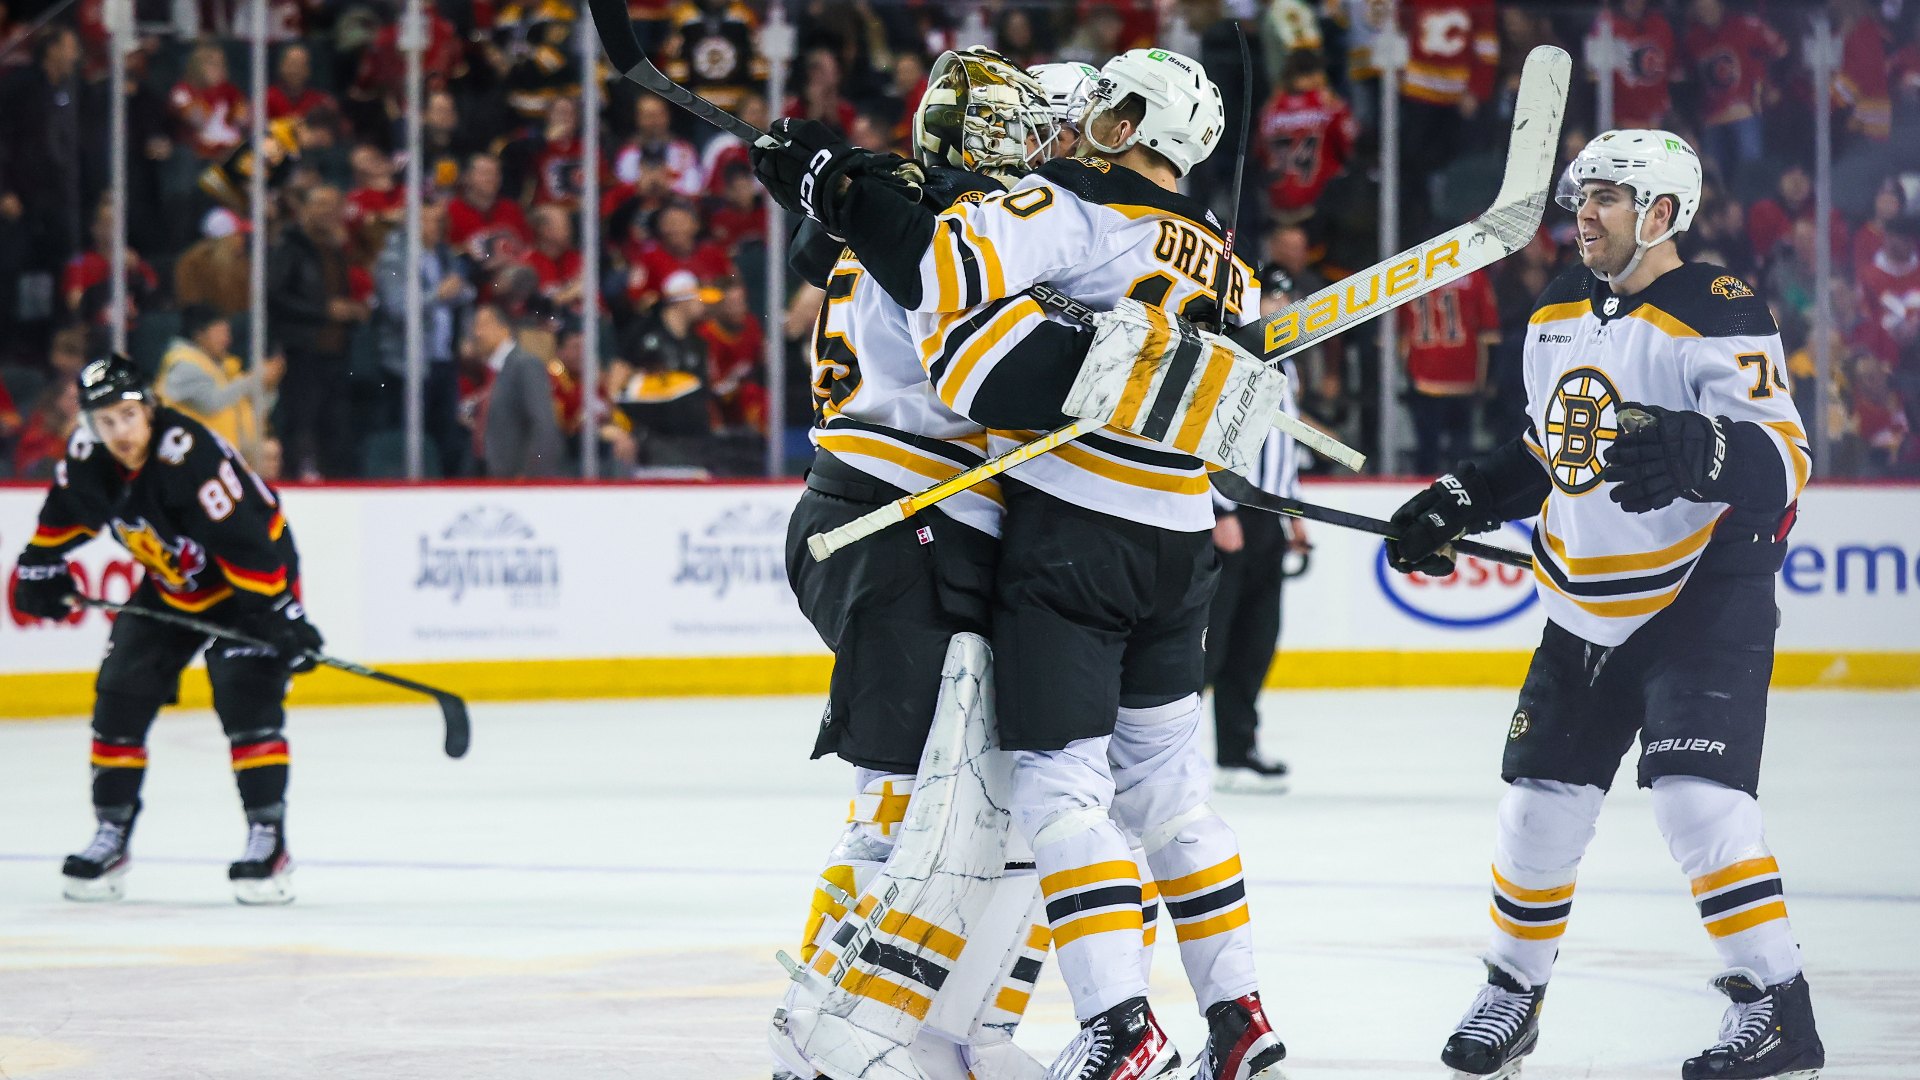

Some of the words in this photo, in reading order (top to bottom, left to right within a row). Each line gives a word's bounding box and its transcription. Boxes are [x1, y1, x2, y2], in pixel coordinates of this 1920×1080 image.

[1168, 56, 1192, 74] Bank
[1201, 126, 1214, 146] 10
[1223, 230, 1234, 261] CCM
